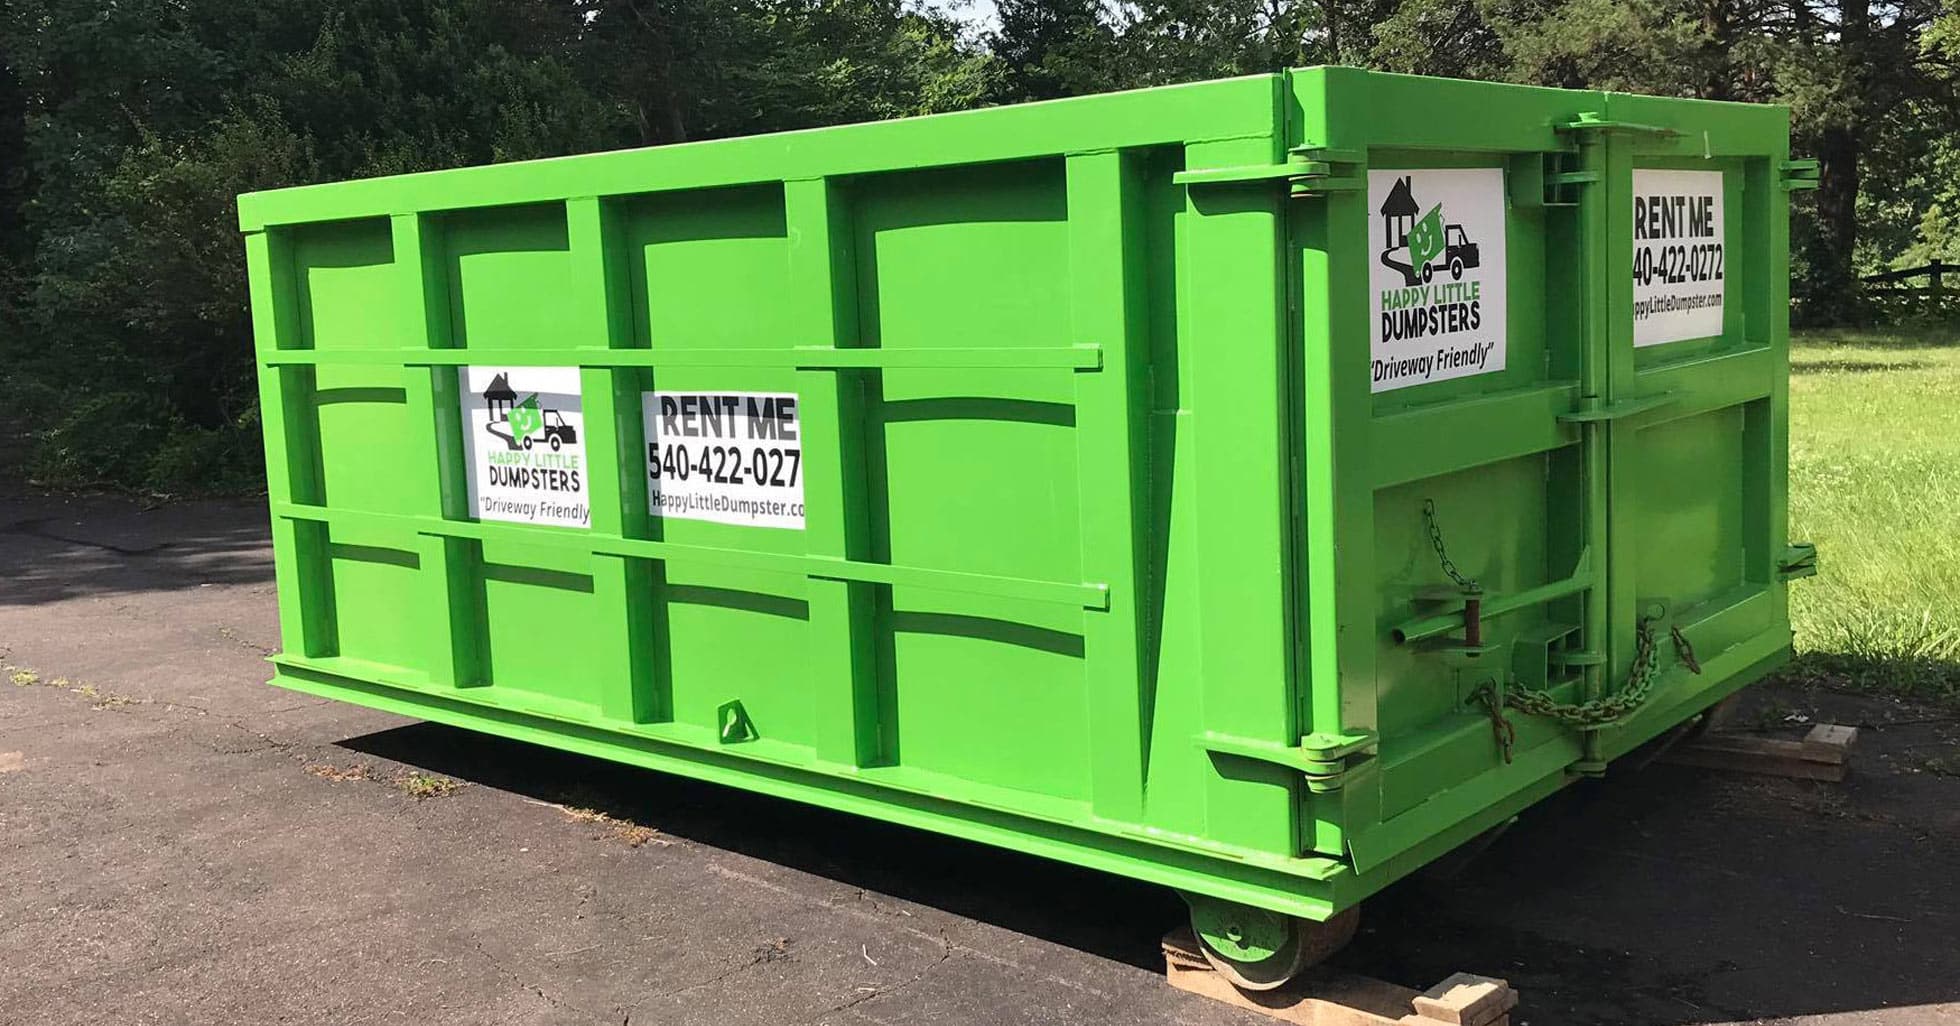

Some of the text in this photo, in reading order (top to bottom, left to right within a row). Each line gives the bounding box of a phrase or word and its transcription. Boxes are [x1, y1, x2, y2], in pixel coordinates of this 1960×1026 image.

[1634, 196, 1713, 239] RENT ME
[1381, 281, 1480, 310] HAPPY LITTLE
[1633, 293, 1722, 320] ppyLittleDumpster.com
[1382, 301, 1480, 343] DUMPSTERS
[661, 395, 797, 441] RENT ME
[488, 451, 579, 470] HAPPY LITTLE
[649, 443, 801, 487] 540-422-027
[489, 466, 581, 492] DUMPSTERS
